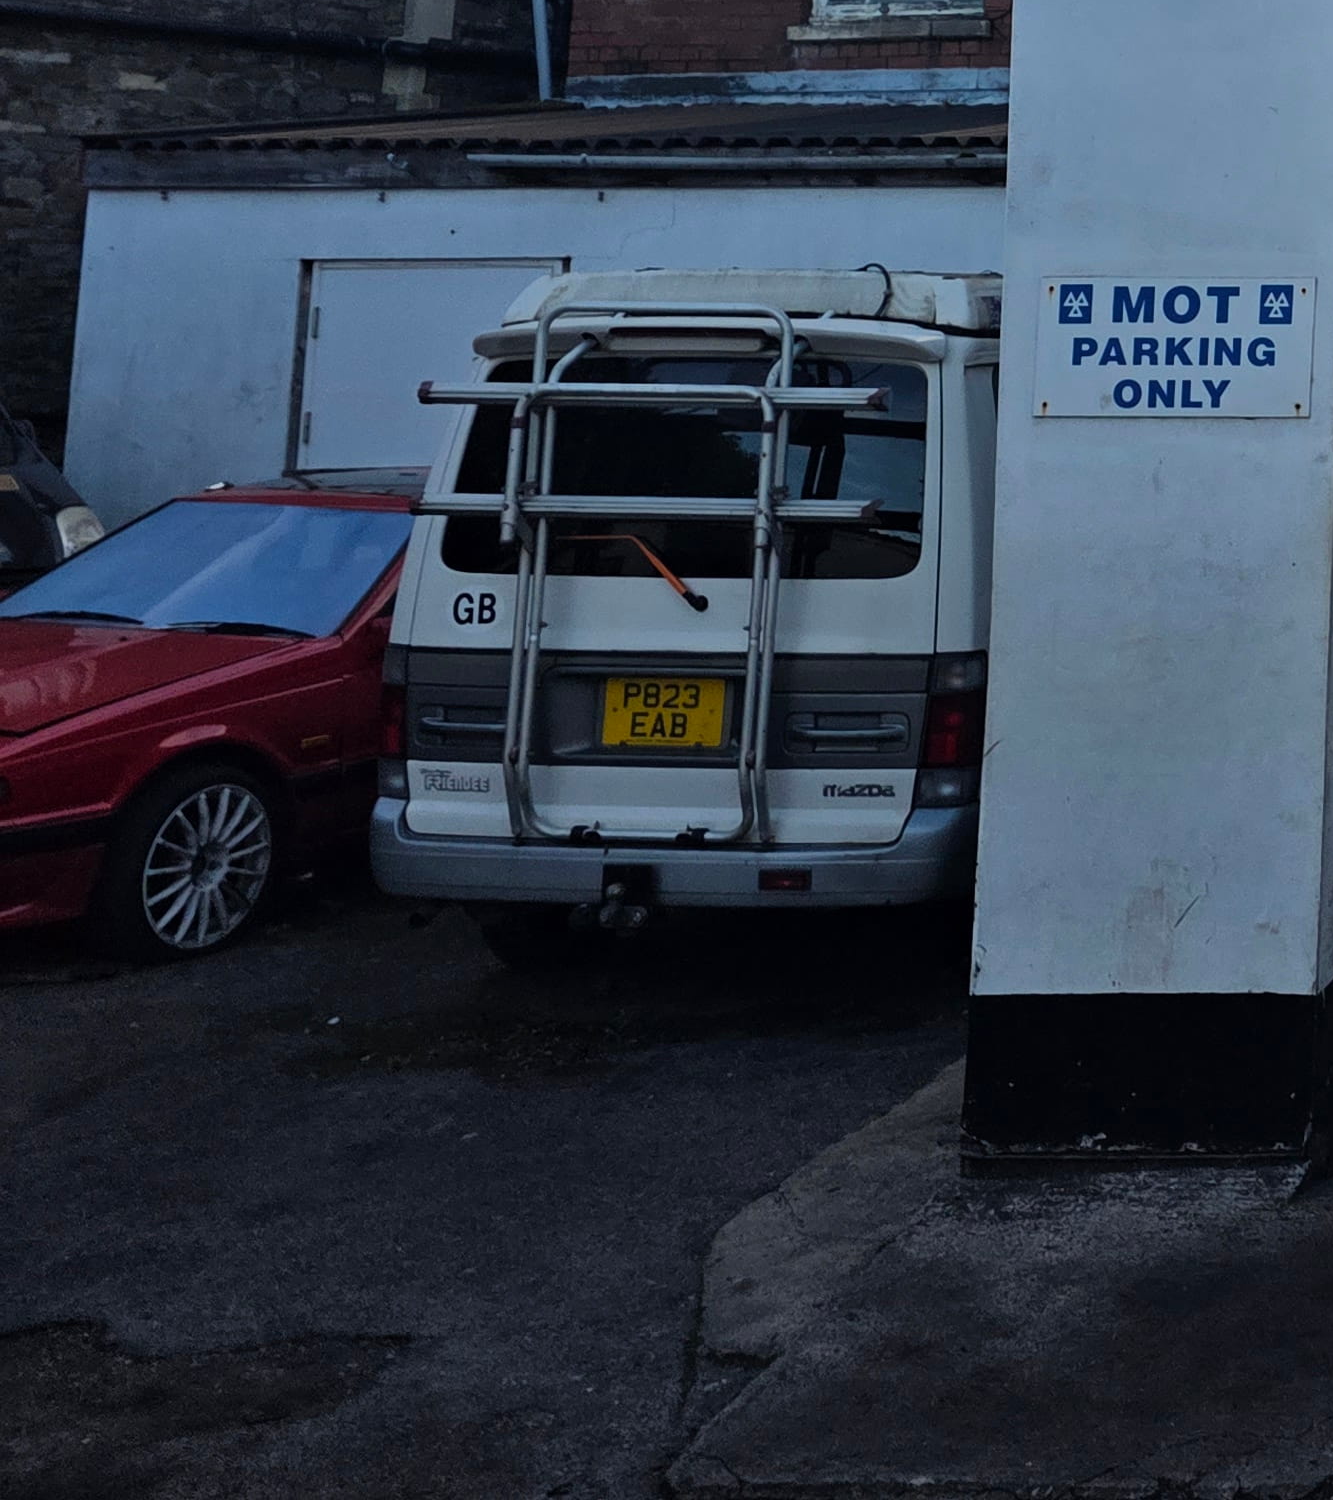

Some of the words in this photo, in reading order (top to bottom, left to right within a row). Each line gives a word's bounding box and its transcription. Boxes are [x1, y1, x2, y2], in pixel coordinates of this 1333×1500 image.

[1111, 285, 1241, 324] MOT
[1071, 337, 1276, 367] PARKING
[1112, 378, 1232, 409] ONLY
[452, 592, 497, 625] GB
[623, 683, 701, 709] P823
[630, 711, 688, 738] EAB
